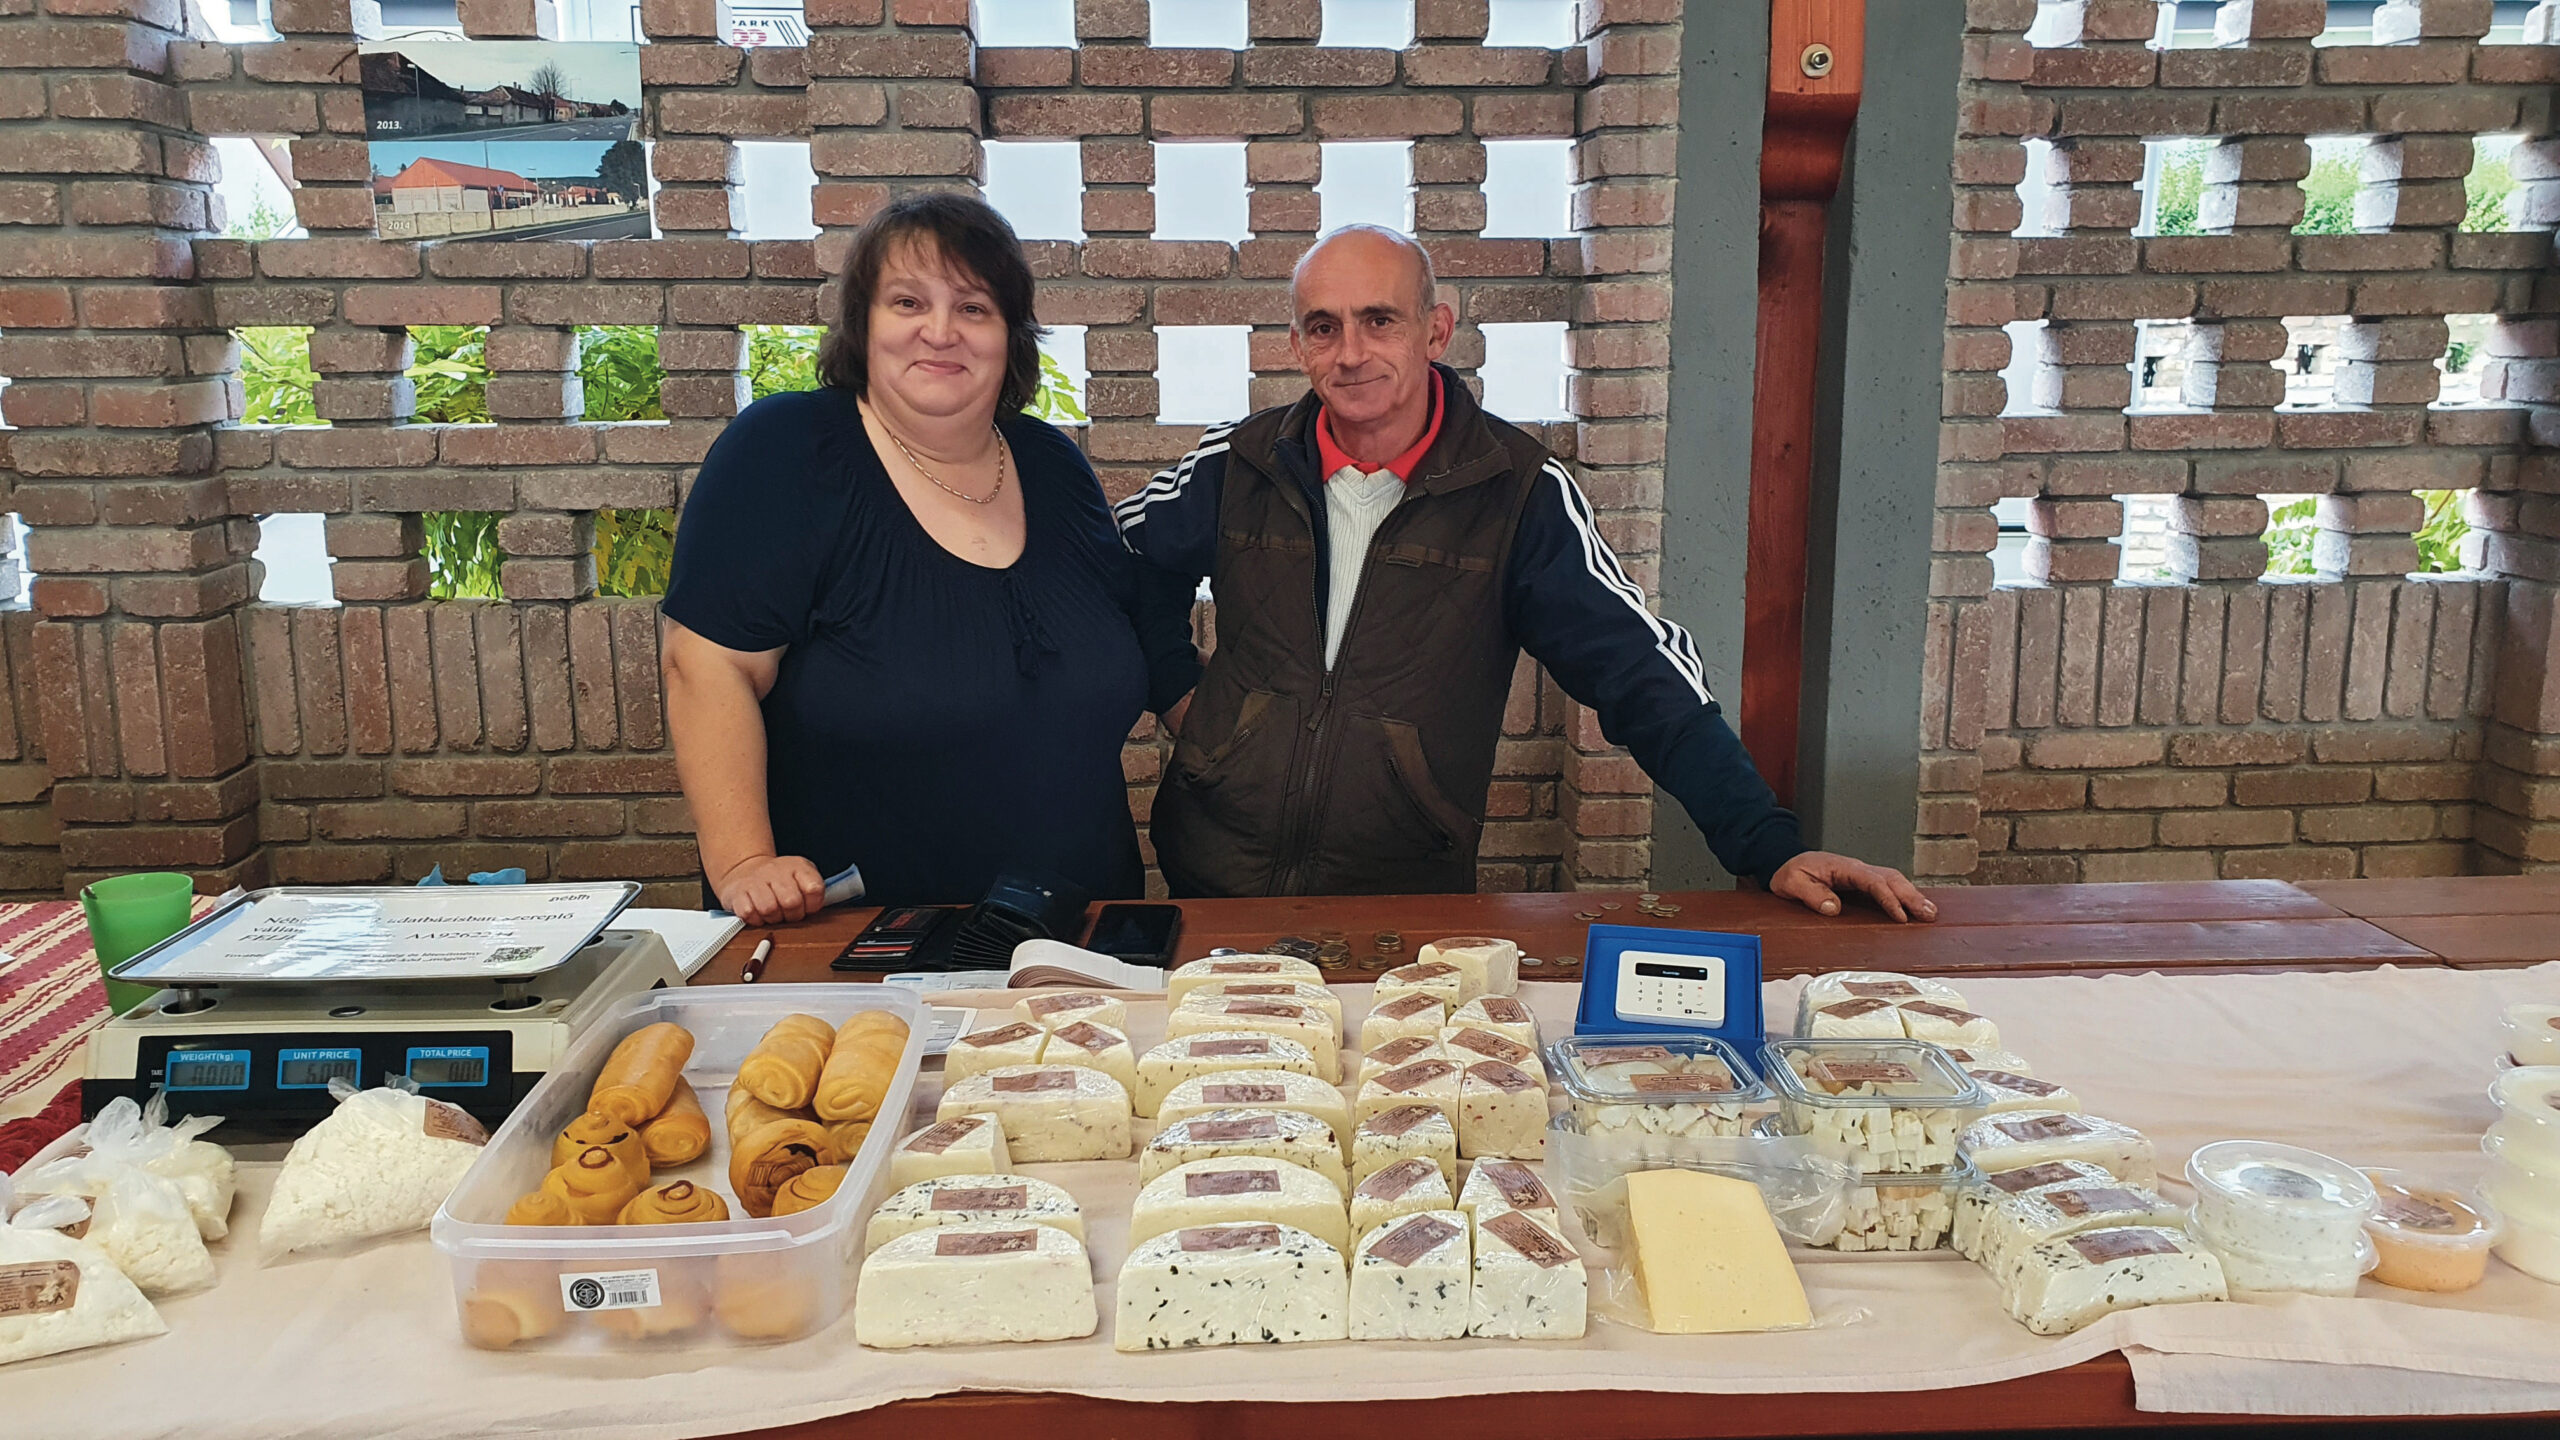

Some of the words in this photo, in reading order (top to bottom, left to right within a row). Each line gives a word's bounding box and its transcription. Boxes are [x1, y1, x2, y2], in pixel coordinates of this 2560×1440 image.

[376, 120, 403, 130] 2013.
[388, 221, 410, 230] 2014
[293, 1051, 318, 1060] UNIT
[319, 1050, 351, 1059] PRICE
[420, 1049, 446, 1057] TOTAL
[447, 1048, 472, 1057] PRICE
[180, 1053, 234, 1062] WEIGHT(kg)
